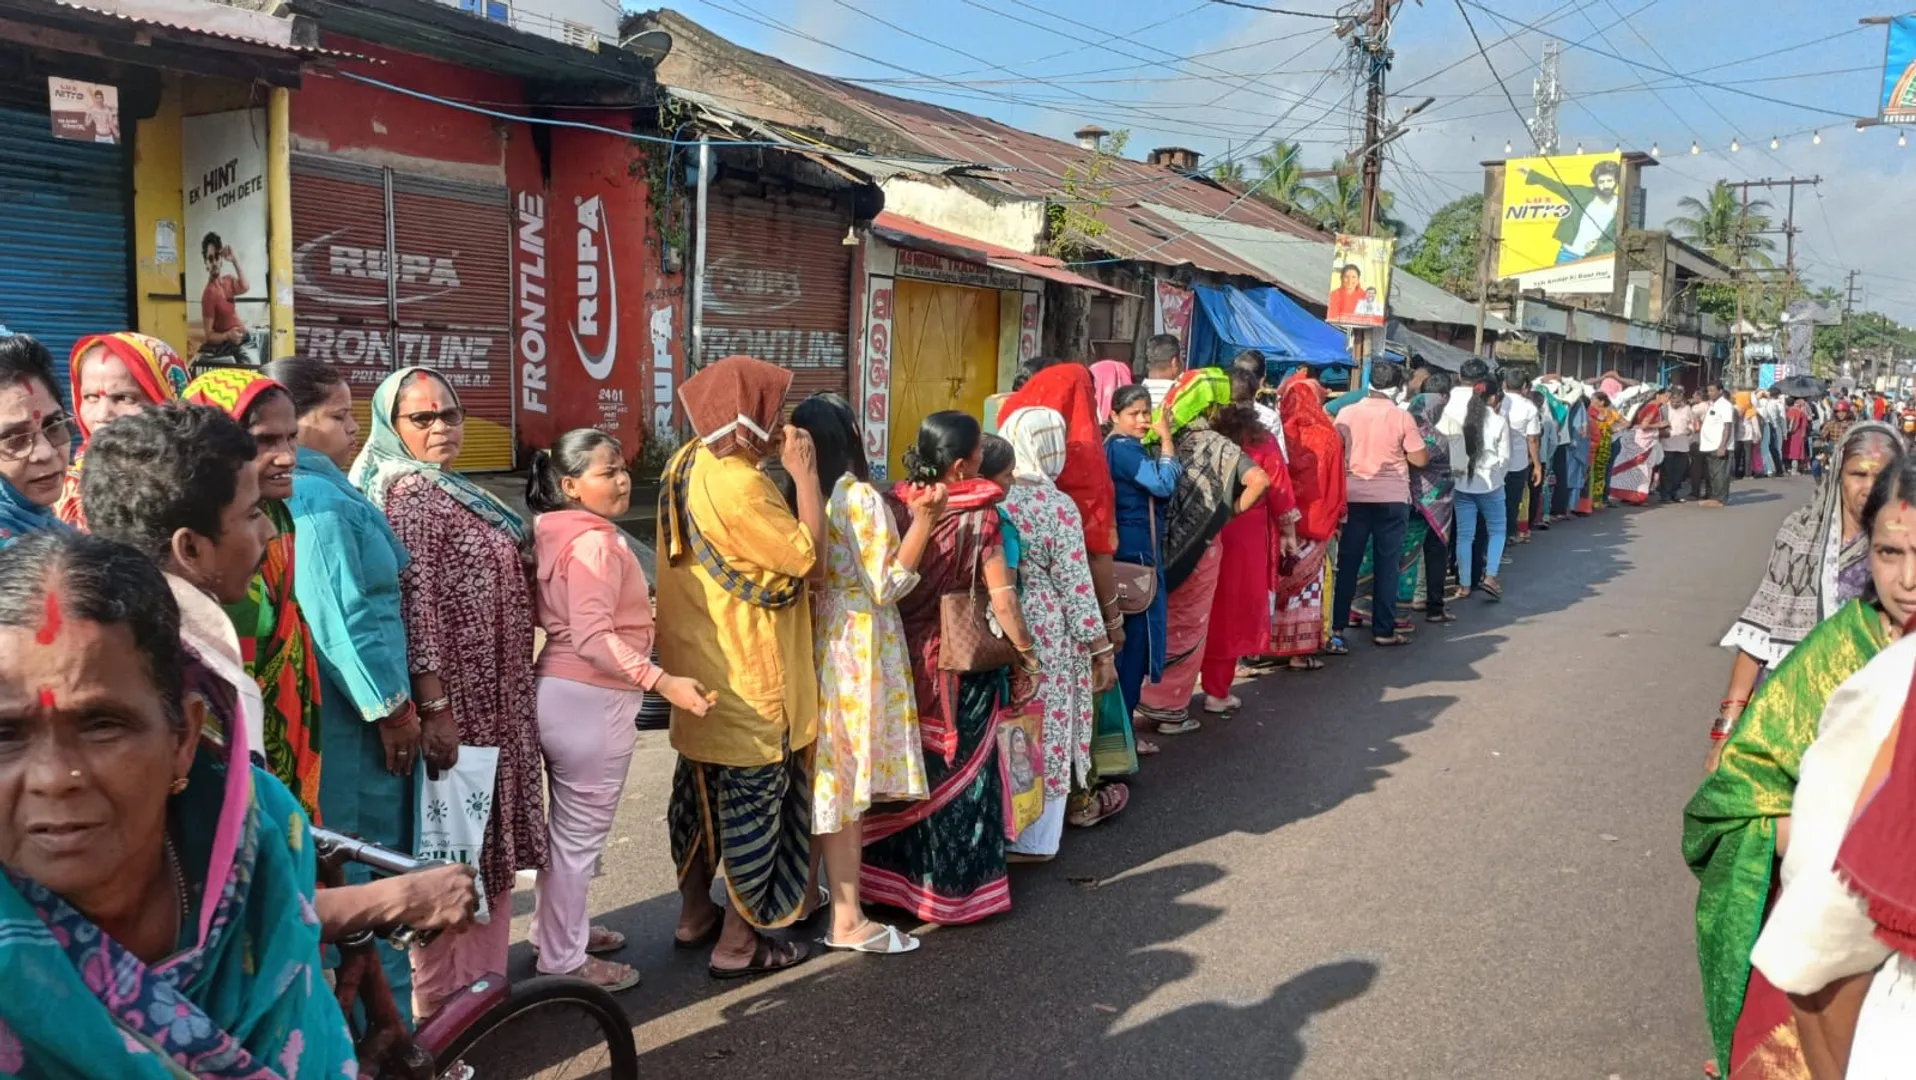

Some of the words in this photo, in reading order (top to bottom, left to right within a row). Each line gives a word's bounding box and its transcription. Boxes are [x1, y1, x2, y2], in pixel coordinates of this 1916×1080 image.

[189, 186, 201, 205] EK
[203, 157, 238, 197] HINT
[216, 188, 236, 210] TOH
[237, 174, 262, 200] DETE
[1505, 204, 1571, 219] NITRO
[330, 246, 460, 287] RUPA
[577, 194, 599, 336] RUPA
[517, 188, 547, 415] FRONTLINE
[295, 326, 493, 369] FRONTLINE
[651, 305, 673, 438] RUPA
